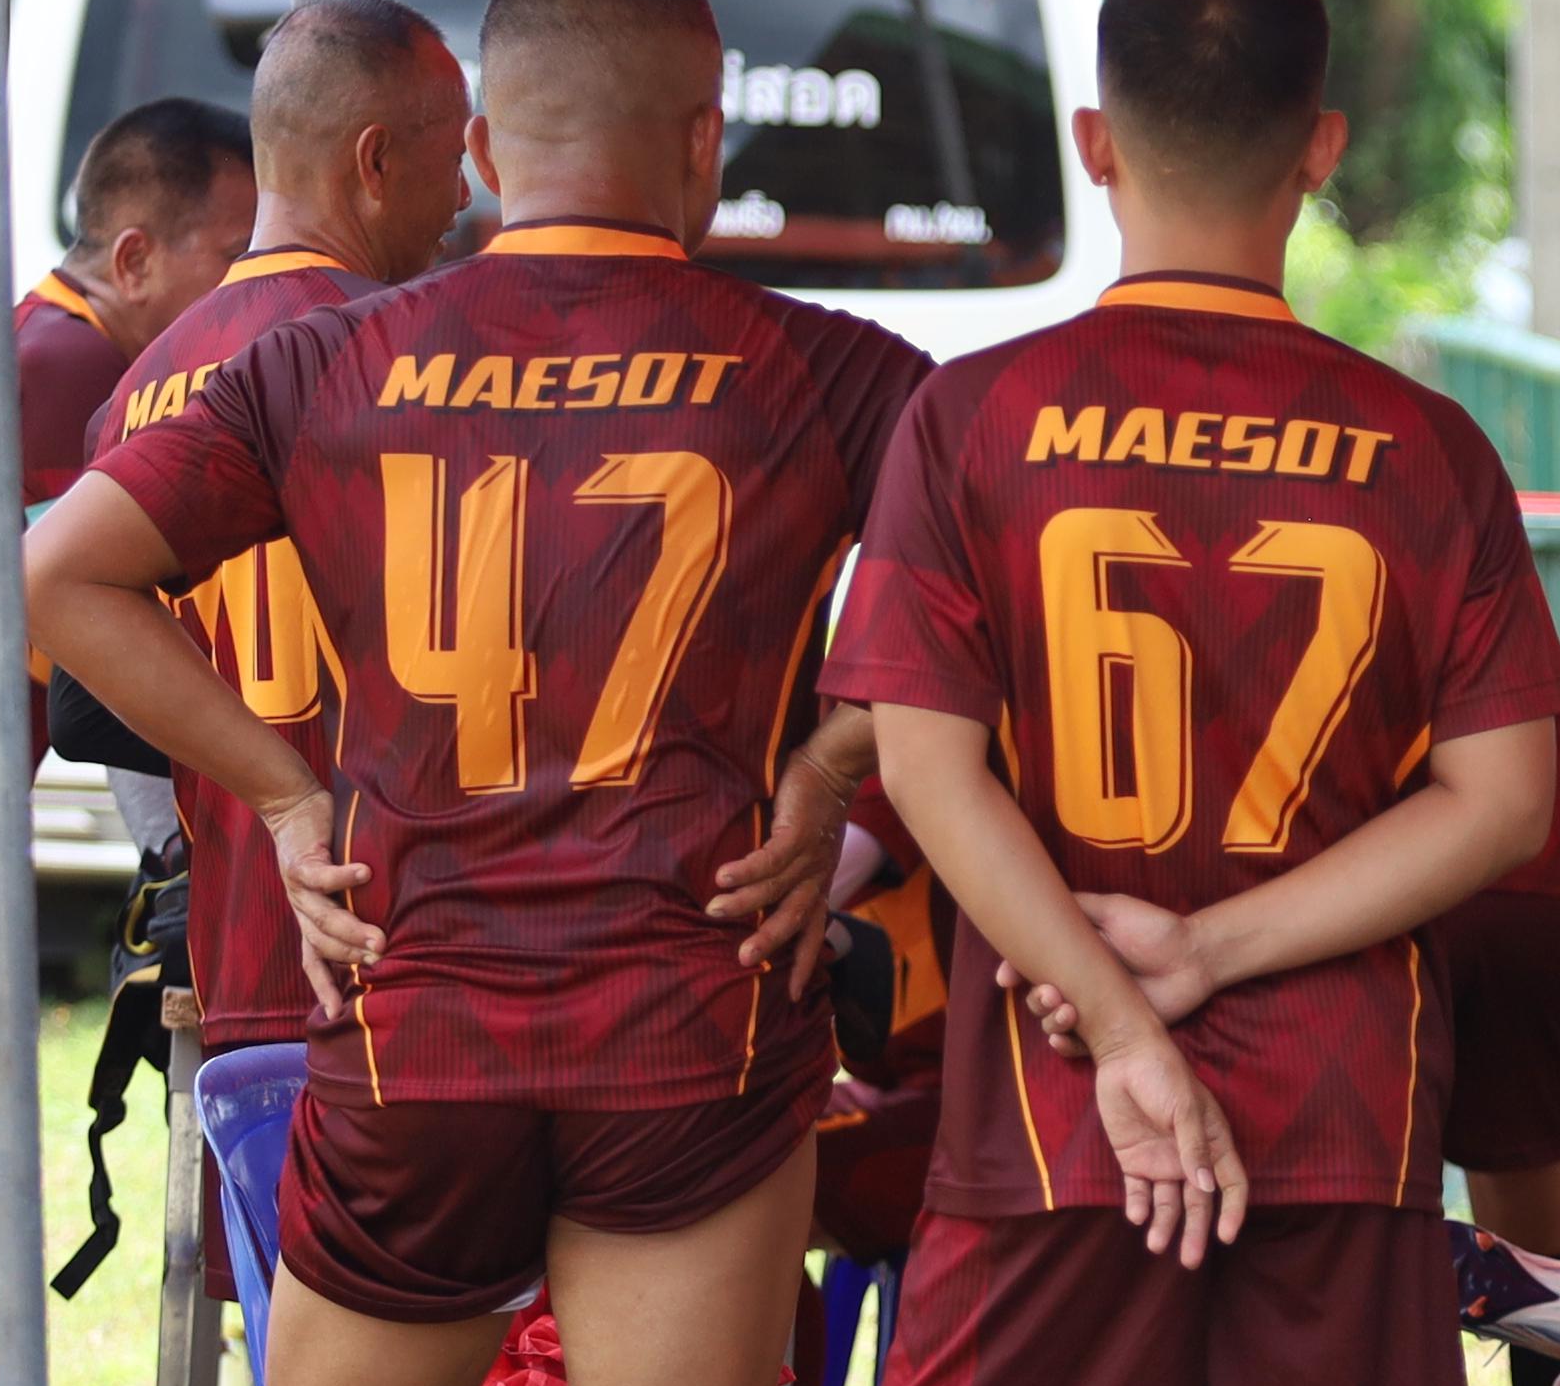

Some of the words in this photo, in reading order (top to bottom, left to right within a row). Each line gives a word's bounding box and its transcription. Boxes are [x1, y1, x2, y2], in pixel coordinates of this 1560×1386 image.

[379, 351, 743, 410] MAESOT
[1025, 405, 1394, 484] MAESOT
[380, 451, 734, 796] 47
[1039, 507, 1387, 855] 67
